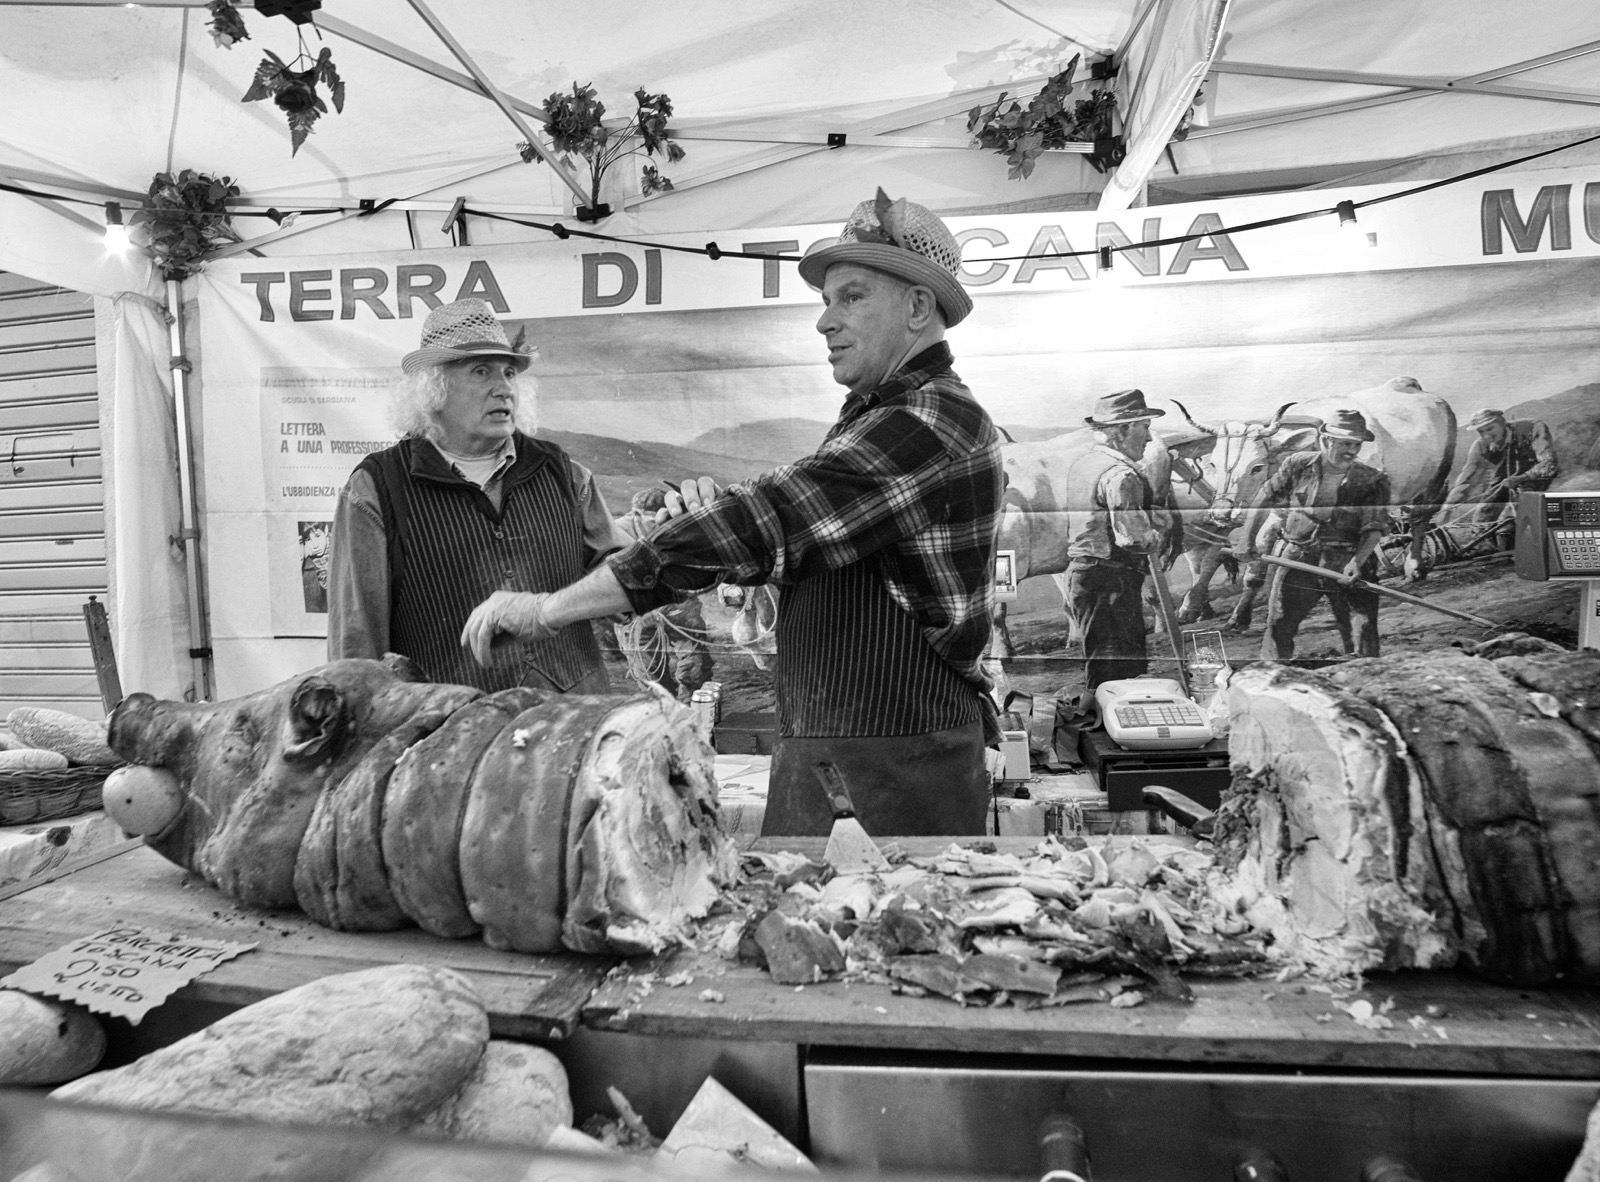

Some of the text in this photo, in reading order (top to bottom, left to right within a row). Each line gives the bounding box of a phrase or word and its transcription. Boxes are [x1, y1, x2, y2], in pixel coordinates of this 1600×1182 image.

[241, 259, 511, 323] TERRA
[581, 248, 663, 309] DI
[742, 211, 1250, 299] TCANA
[281, 422, 326, 436] LETTERA
[281, 439, 399, 454] A UNA PROFESSORE
[282, 486, 336, 497] L'UBBIDIENZA
